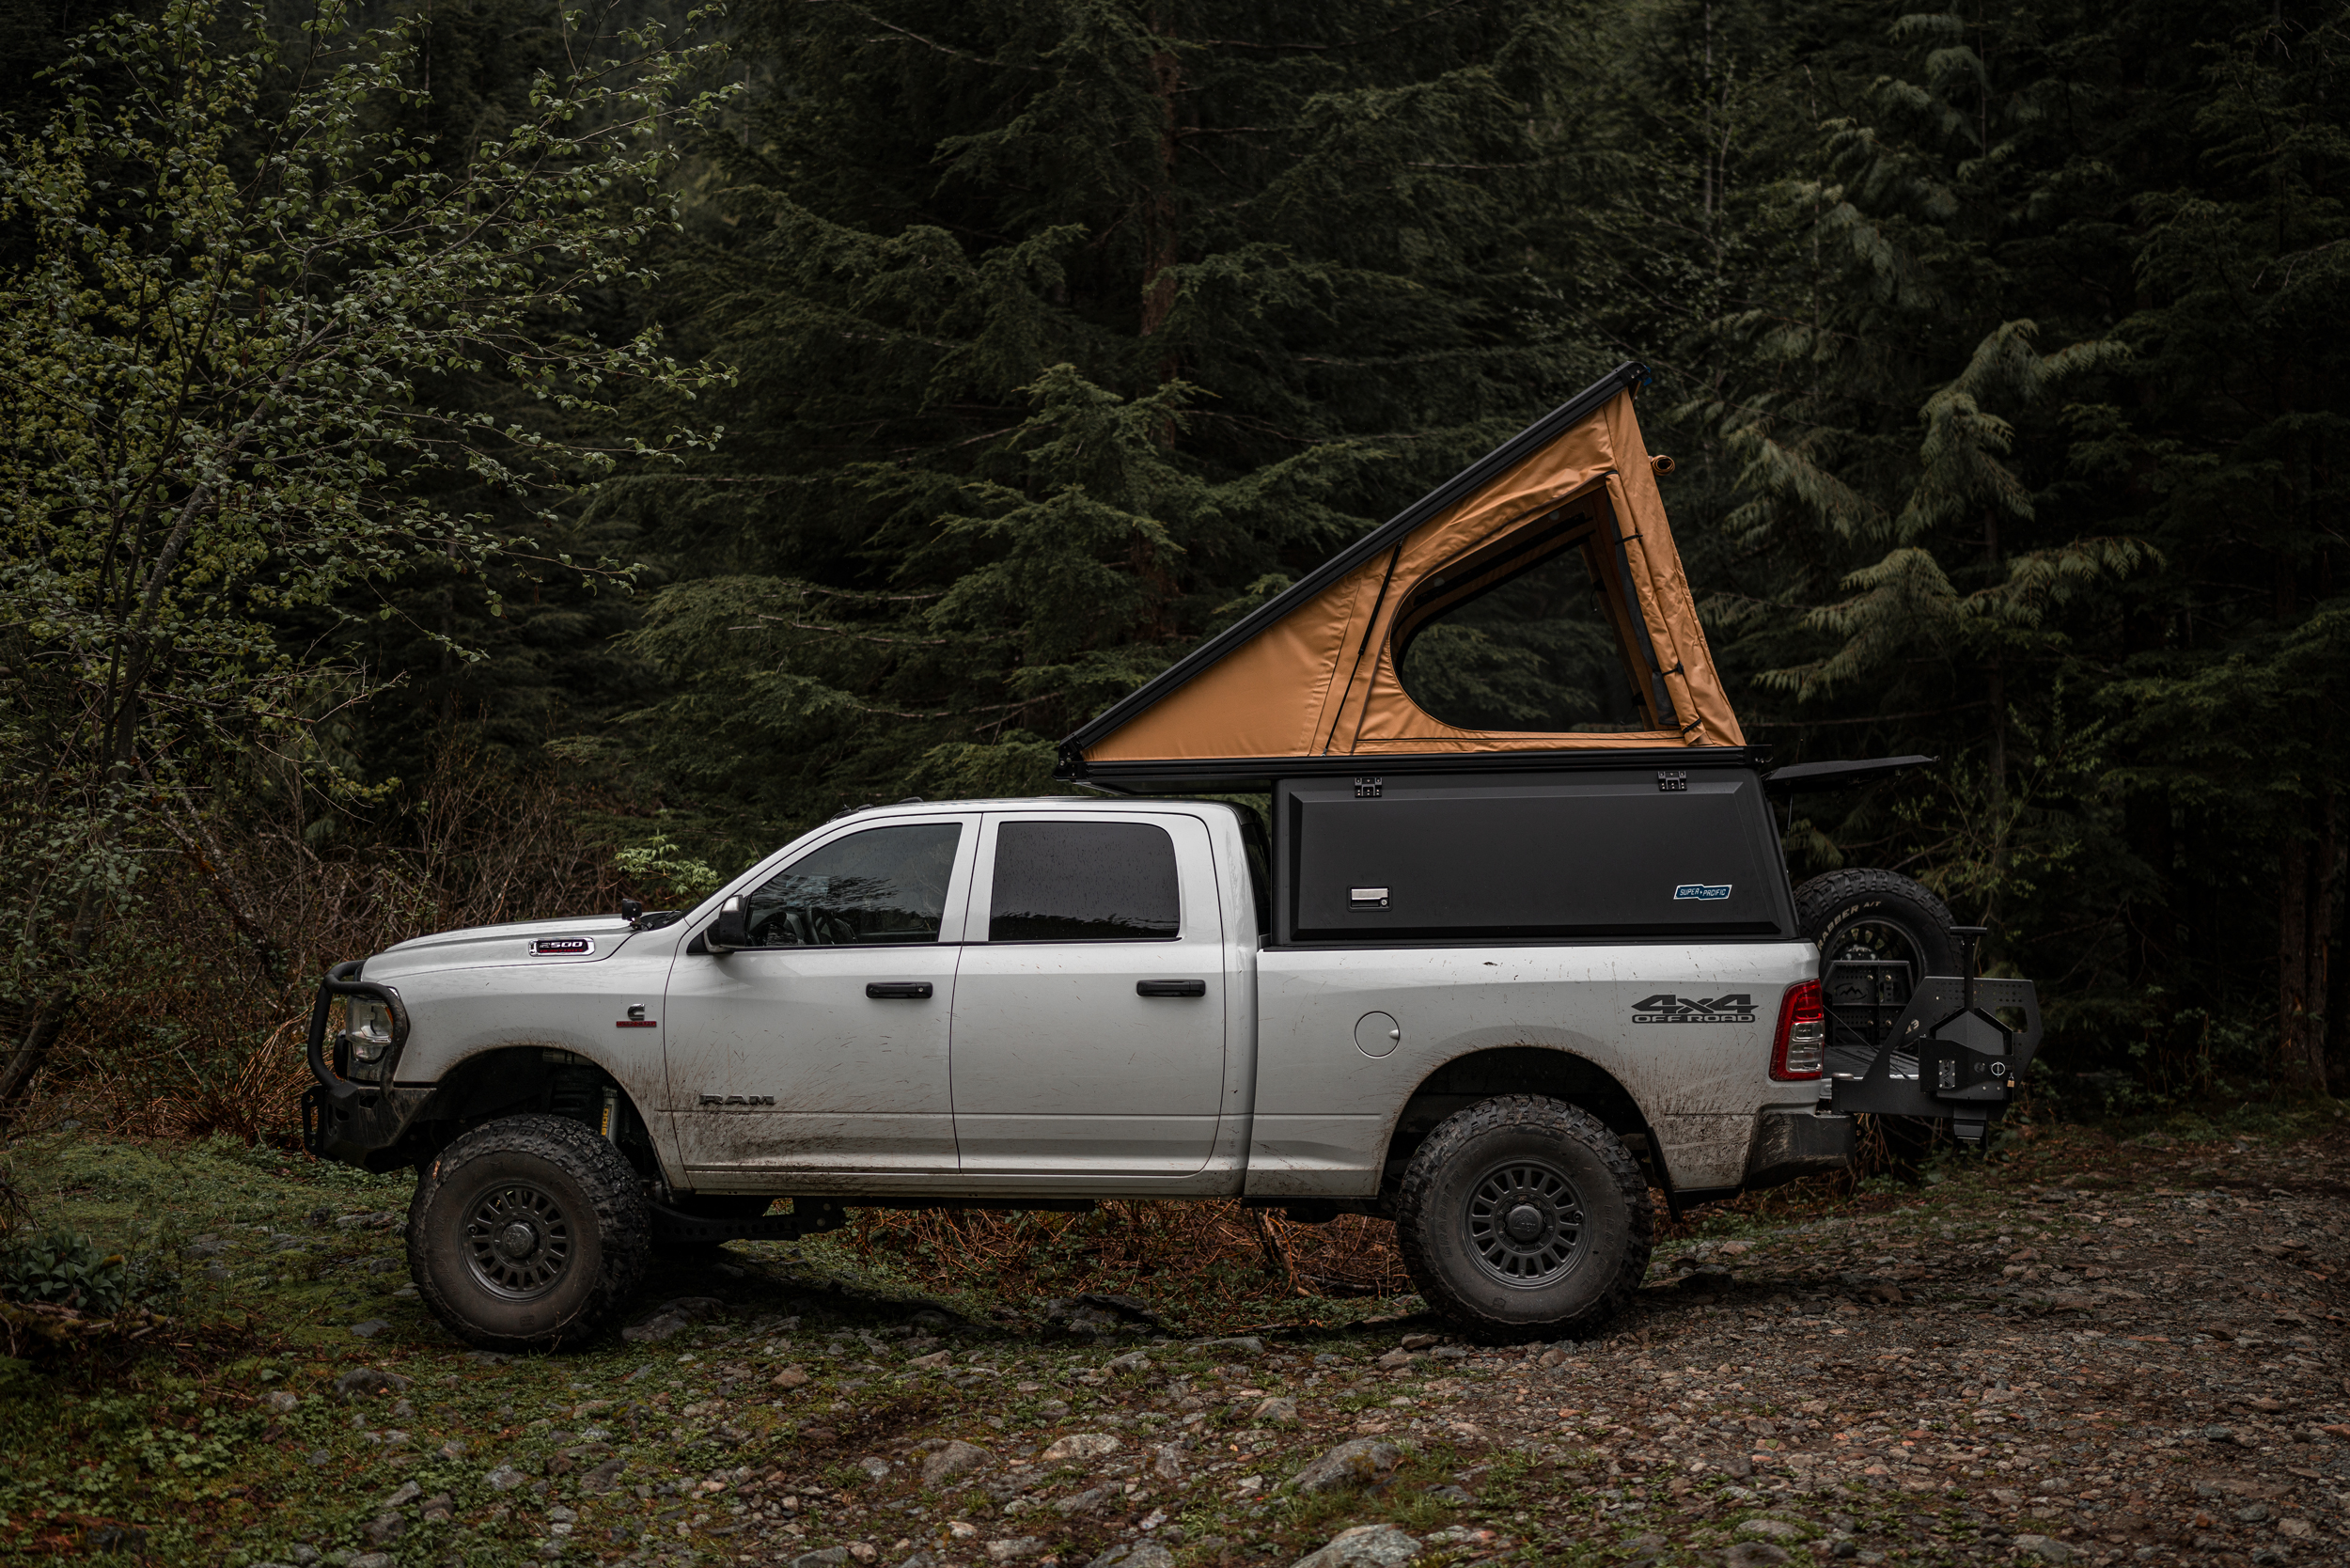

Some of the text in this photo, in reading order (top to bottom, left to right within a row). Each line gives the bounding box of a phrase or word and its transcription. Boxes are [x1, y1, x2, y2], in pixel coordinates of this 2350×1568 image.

[1679, 887, 1727, 897] SUPER PACIFIC
[1817, 904, 1859, 950] RABBER
[703, 1096, 775, 1105] RAM
